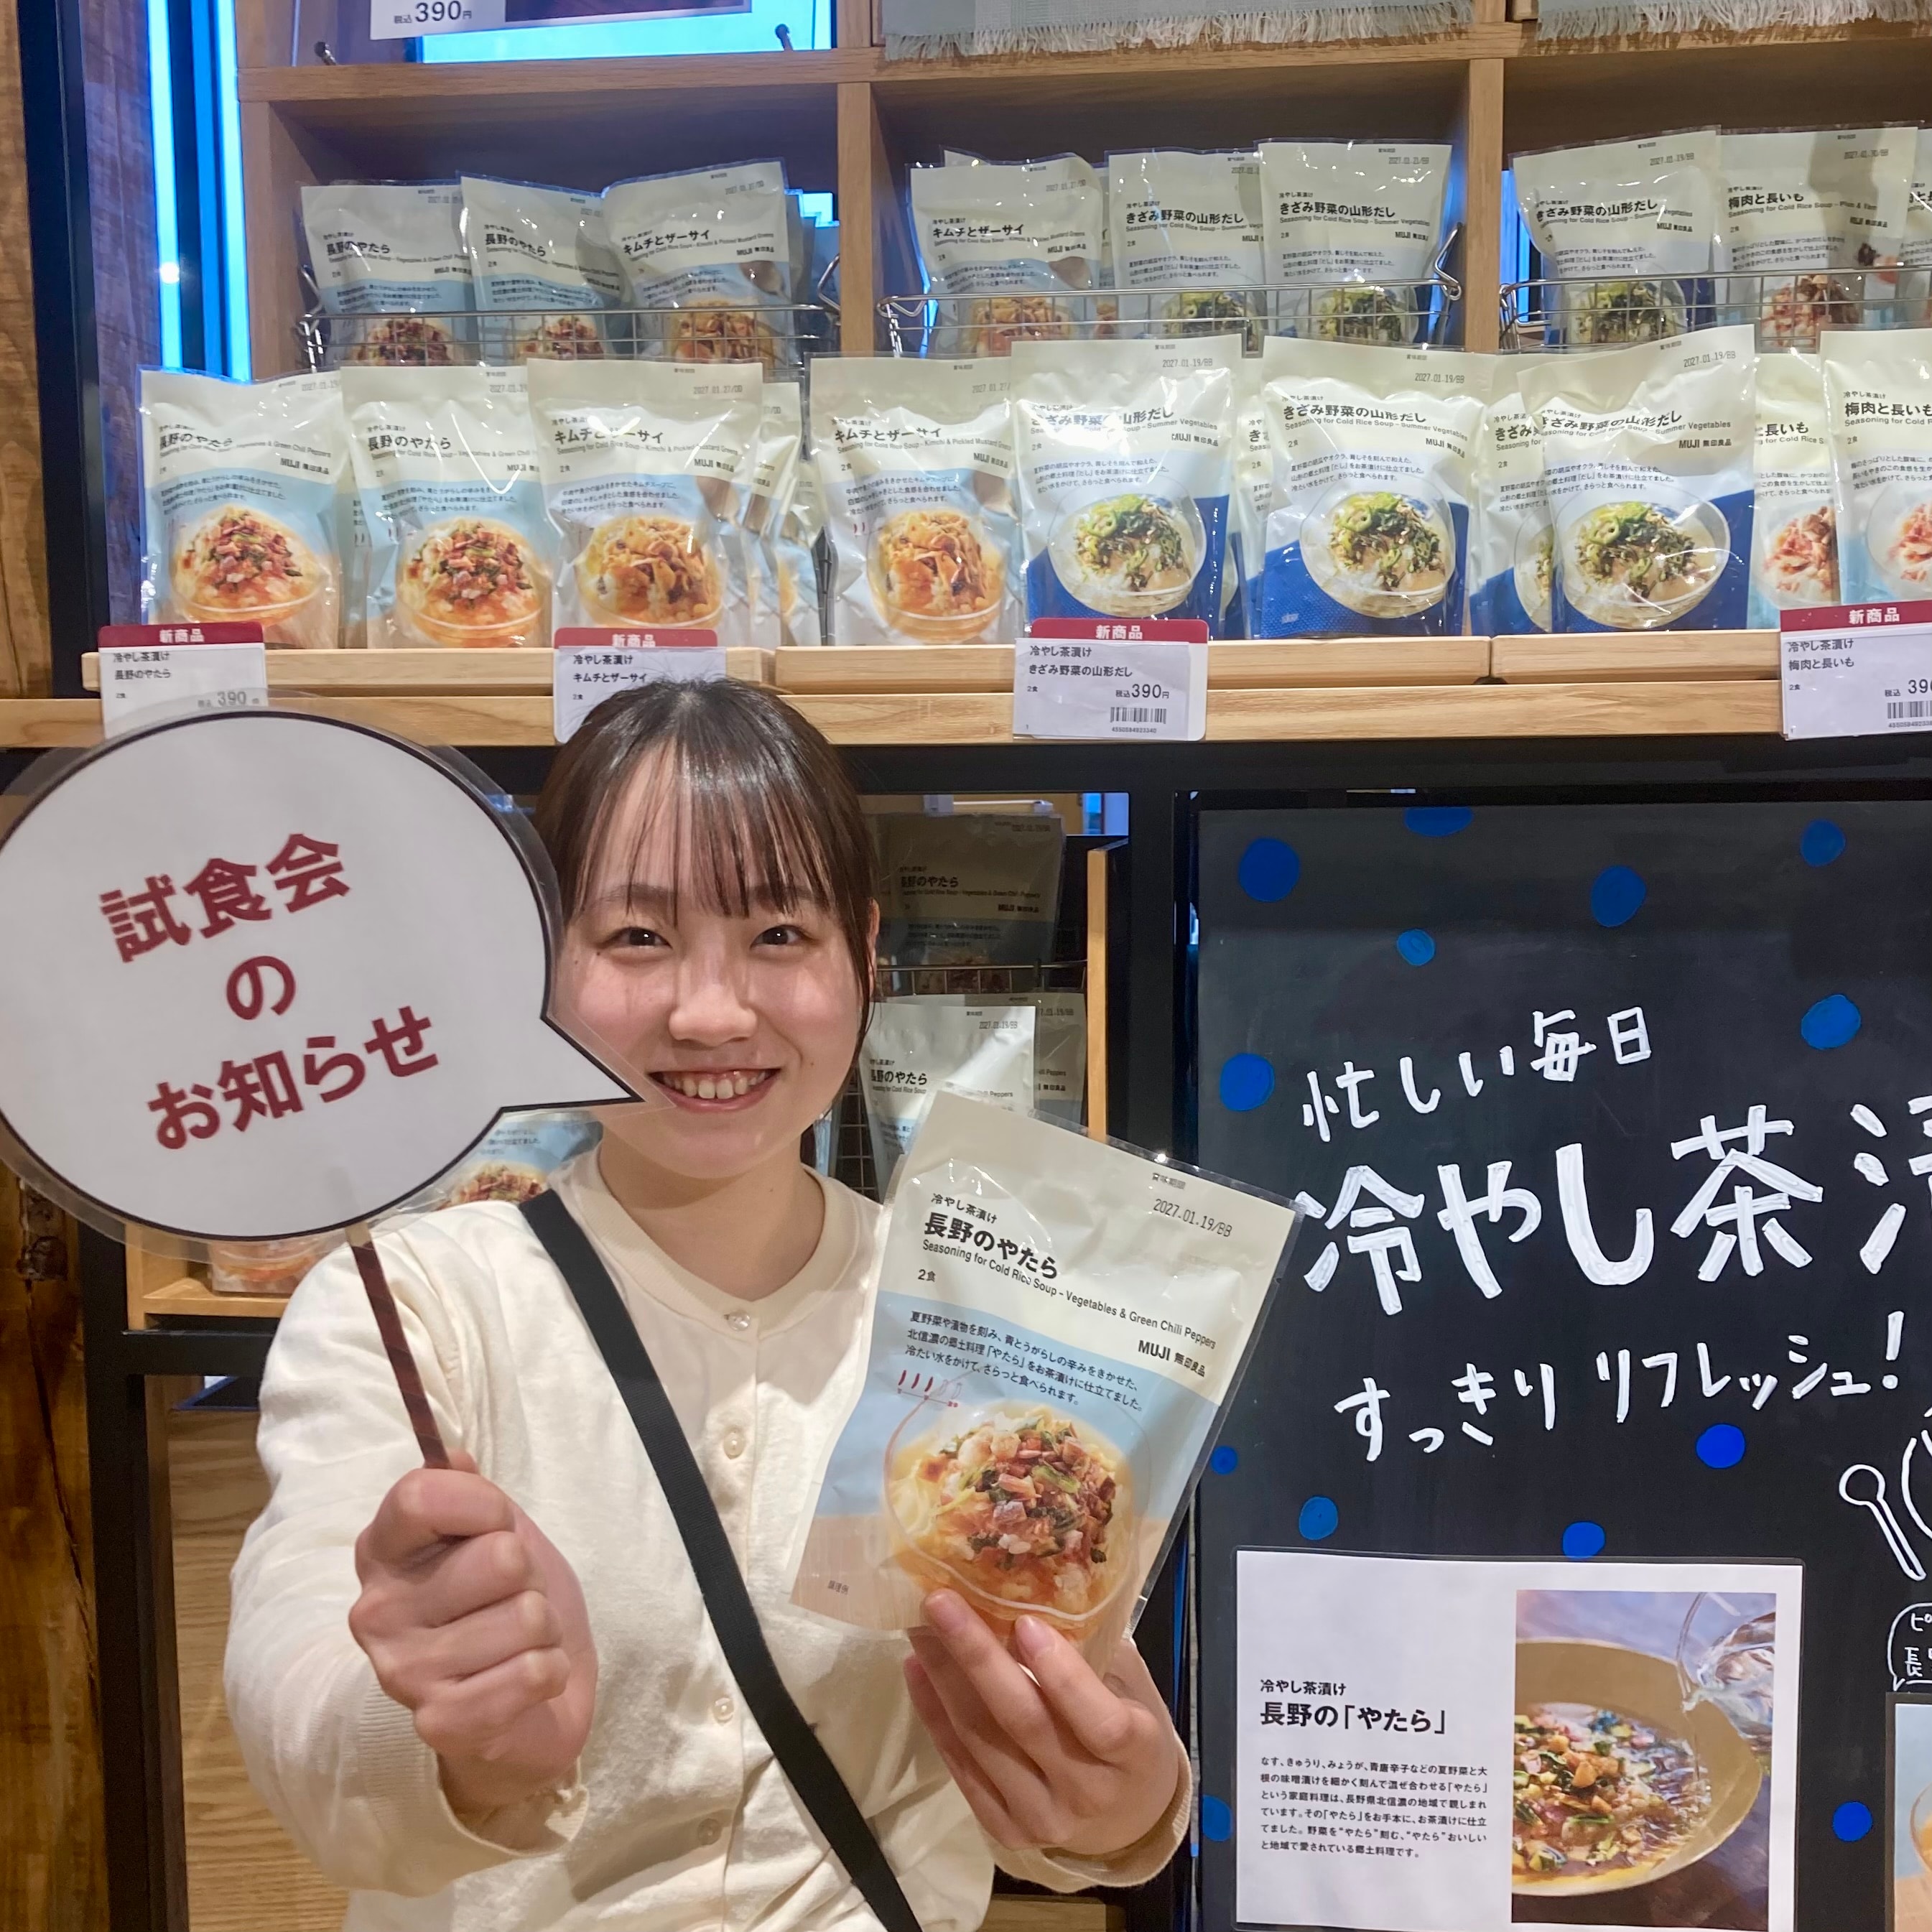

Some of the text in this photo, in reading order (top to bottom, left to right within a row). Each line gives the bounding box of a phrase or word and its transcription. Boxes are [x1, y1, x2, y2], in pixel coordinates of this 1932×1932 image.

[1280, 201, 1395, 217] きざみ野菜の山形だし
[1729, 192, 1803, 210] 梅肉と長いも
[1126, 210, 1243, 224] きざみ野菜の山形だし
[933, 224, 1023, 238] キムチとザーサイ
[485, 233, 546, 256] 長野のやたら
[623, 230, 710, 255] キムチとザーサイ
[1283, 404, 1426, 422] きざみ野菜の山形だし
[1148, 418, 1218, 430] Summer Vegetables
[1655, 422, 1686, 435] Summer
[1689, 420, 1731, 429] Vegetables
[1844, 417, 1889, 427] Seasoning
[835, 427, 942, 443] キムチとザーサイ
[1171, 434, 1218, 447] MUJI 無印良品
[1433, 426, 1467, 441] Vegetables
[1426, 438, 1444, 447] MUJI
[1496, 441, 1529, 451] Seasoning
[1678, 439, 1732, 449] MUJI 無印良品
[1849, 607, 1900, 625] 新商品
[159, 628, 205, 644] 新商品
[612, 633, 656, 648] 新商品
[1095, 625, 1143, 640] 新商品
[1030, 645, 1092, 658] 冷やし茶漬け
[1788, 638, 1854, 653] 冷やし茶漬け
[113, 651, 169, 663] 冷やし茶漬け
[573, 654, 633, 665] 冷やし茶漬け
[1789, 657, 1854, 671] 梅肉と長いも
[114, 669, 172, 680] 長野のやたら
[573, 673, 647, 682] キムチとザーサイ
[1028, 664, 1133, 677] きざみ野菜の山形だし
[1115, 683, 1169, 699] 税込390円
[1908, 679, 1932, 695] 39
[217, 691, 247, 706] 390
[98, 832, 350, 963] 試食会
[226, 954, 297, 1021] の
[147, 1005, 440, 1150] お知らせ
[1301, 1006, 1652, 1142] 忙しい毎日
[932, 1192, 998, 1225] 冷やし茶漬け
[1153, 1198, 1232, 1237] 2027.01.19/BB
[924, 1212, 1058, 1280] 長野のやたら
[918, 1268, 936, 1283] 2食
[922, 1239, 1216, 1350] Seasoning for Cold Rice Soup Vegetables & Green Chili Peppers
[1138, 1339, 1206, 1378] MUJI 無印良品
[905, 1344, 1079, 1406] 冷たい水をかけて、さらっと食べられます。
[1334, 1362, 1555, 1462] すっきり
[1259, 1679, 1347, 1696] 冷やし茶漬け
[1260, 1701, 1446, 1735] 長野の「やたら」
[1260, 1756, 1488, 1776] なす、きゅうり、みょうが、青唐辛子などの夏野菜と大
[1260, 1773, 1488, 1793] 根の味噌漬けを細かく刻んで混ぜ合わせる「やたら」
[1260, 1791, 1487, 1809] という家庭料理は、長野県北信濃の地域で親しまれ
[1260, 1807, 1487, 1826] ています。その「やたら」をお手本に、お茶漬けに仕立
[1260, 1840, 1419, 1858] と地域で愛されている郷土料理です。
